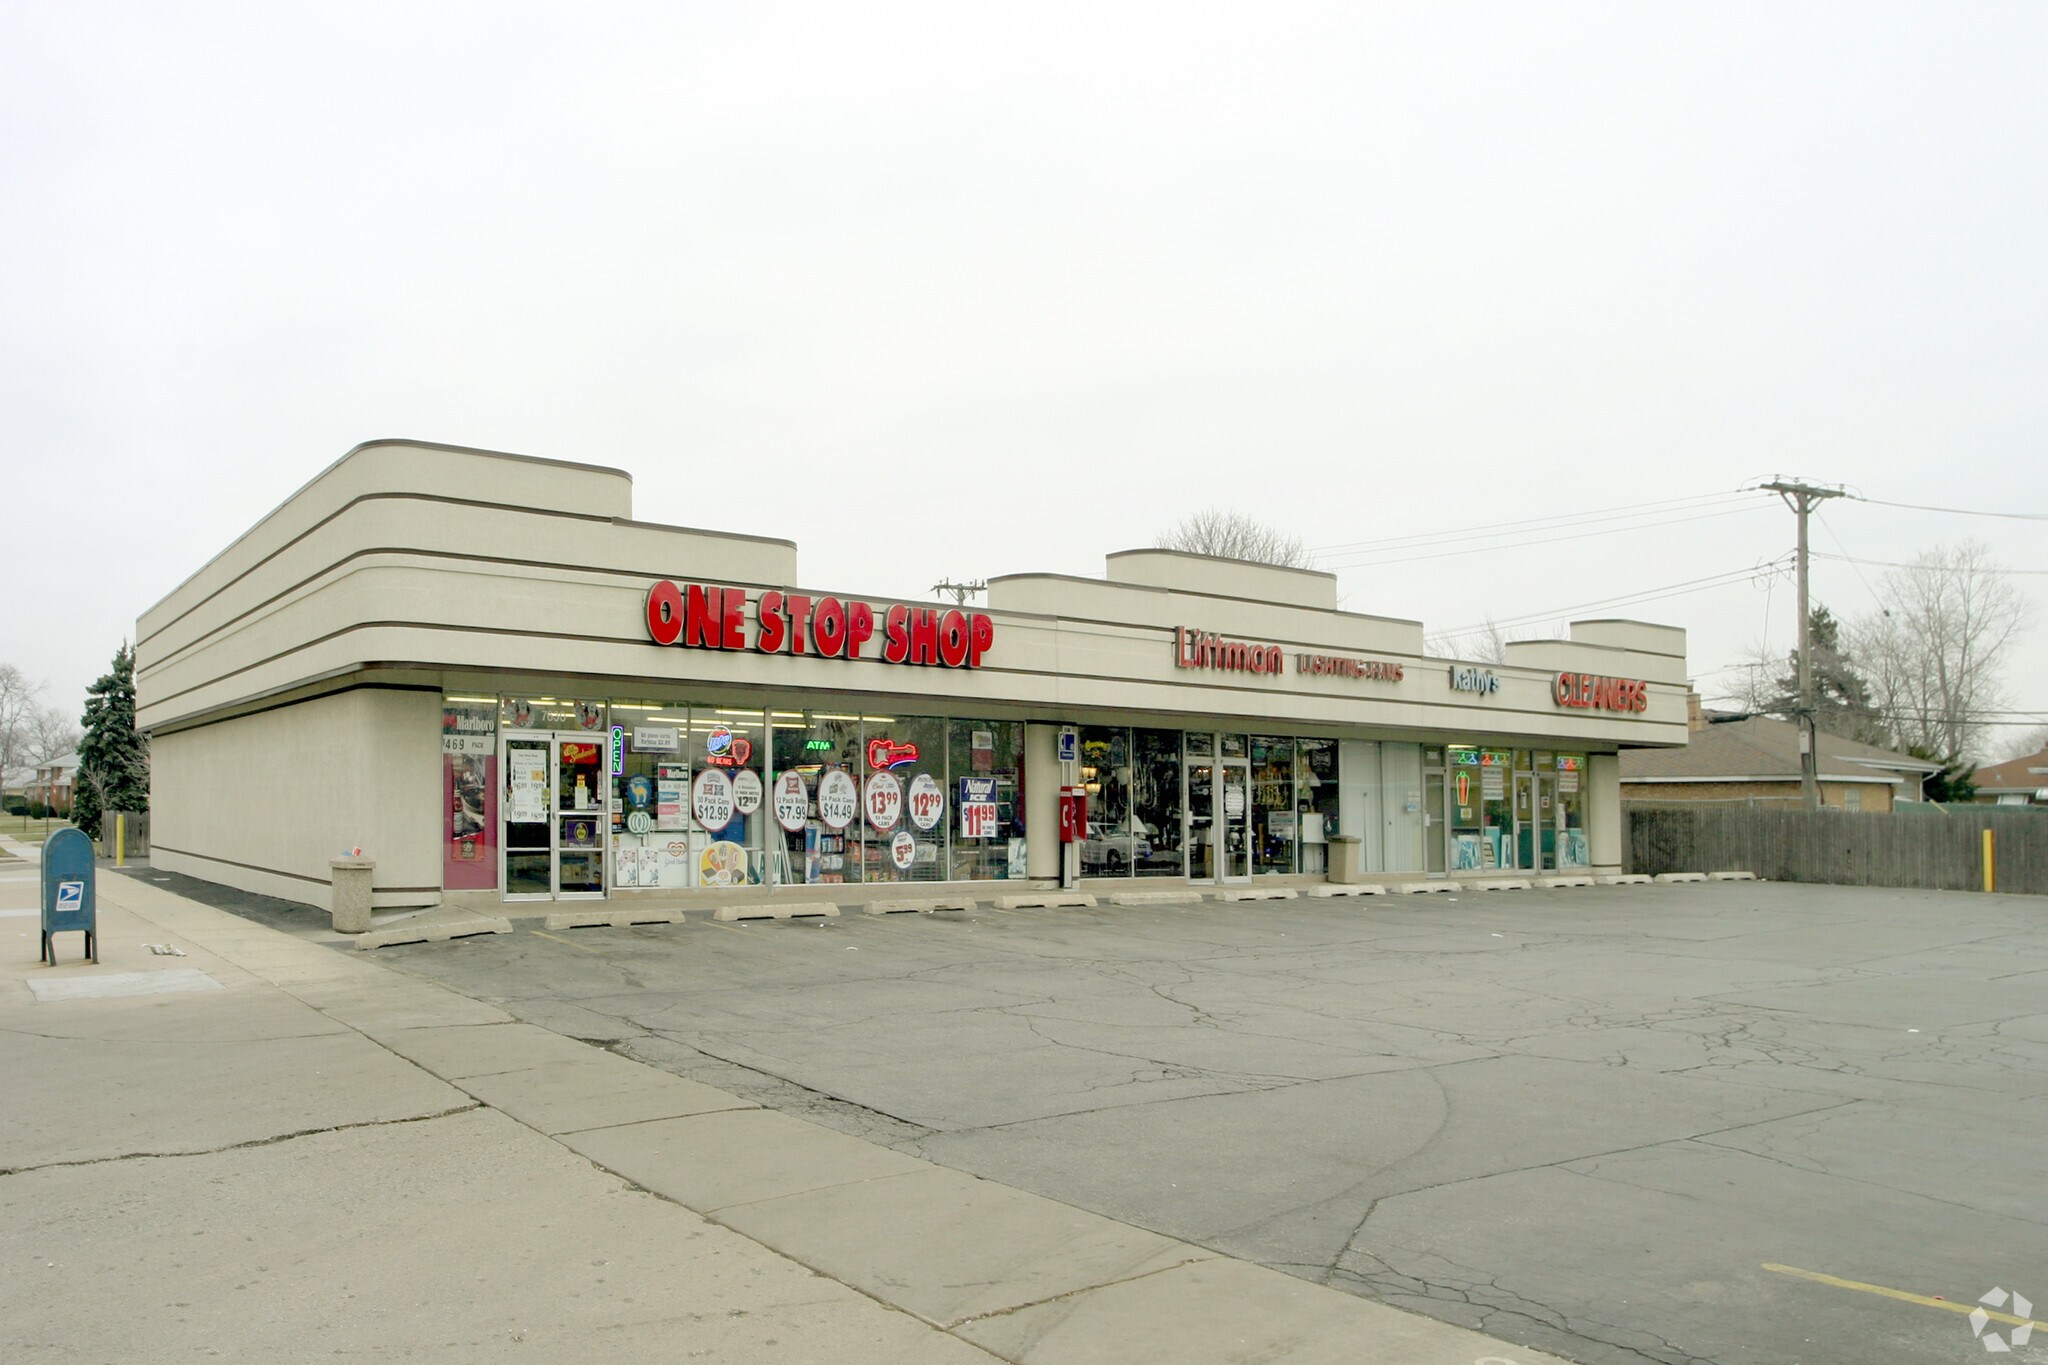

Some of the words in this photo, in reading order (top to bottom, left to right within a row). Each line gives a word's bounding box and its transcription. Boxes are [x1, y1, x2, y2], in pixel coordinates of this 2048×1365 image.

[644, 579, 747, 649] ONE
[757, 591, 874, 658] STOP
[882, 603, 994, 668] SHOP
[1175, 626, 1283, 674] Littman
[1552, 671, 1648, 712] CLEANERS
[456, 715, 495, 731] Marlboro
[612, 728, 622, 772] OPEN
[807, 740, 830, 751] ATM
[964, 779, 994, 794] Natural
[705, 796, 716, 804] Pack
[698, 804, 729, 821] $12.99
[779, 805, 805, 819] $7.99
[823, 803, 852, 820] $14.49
